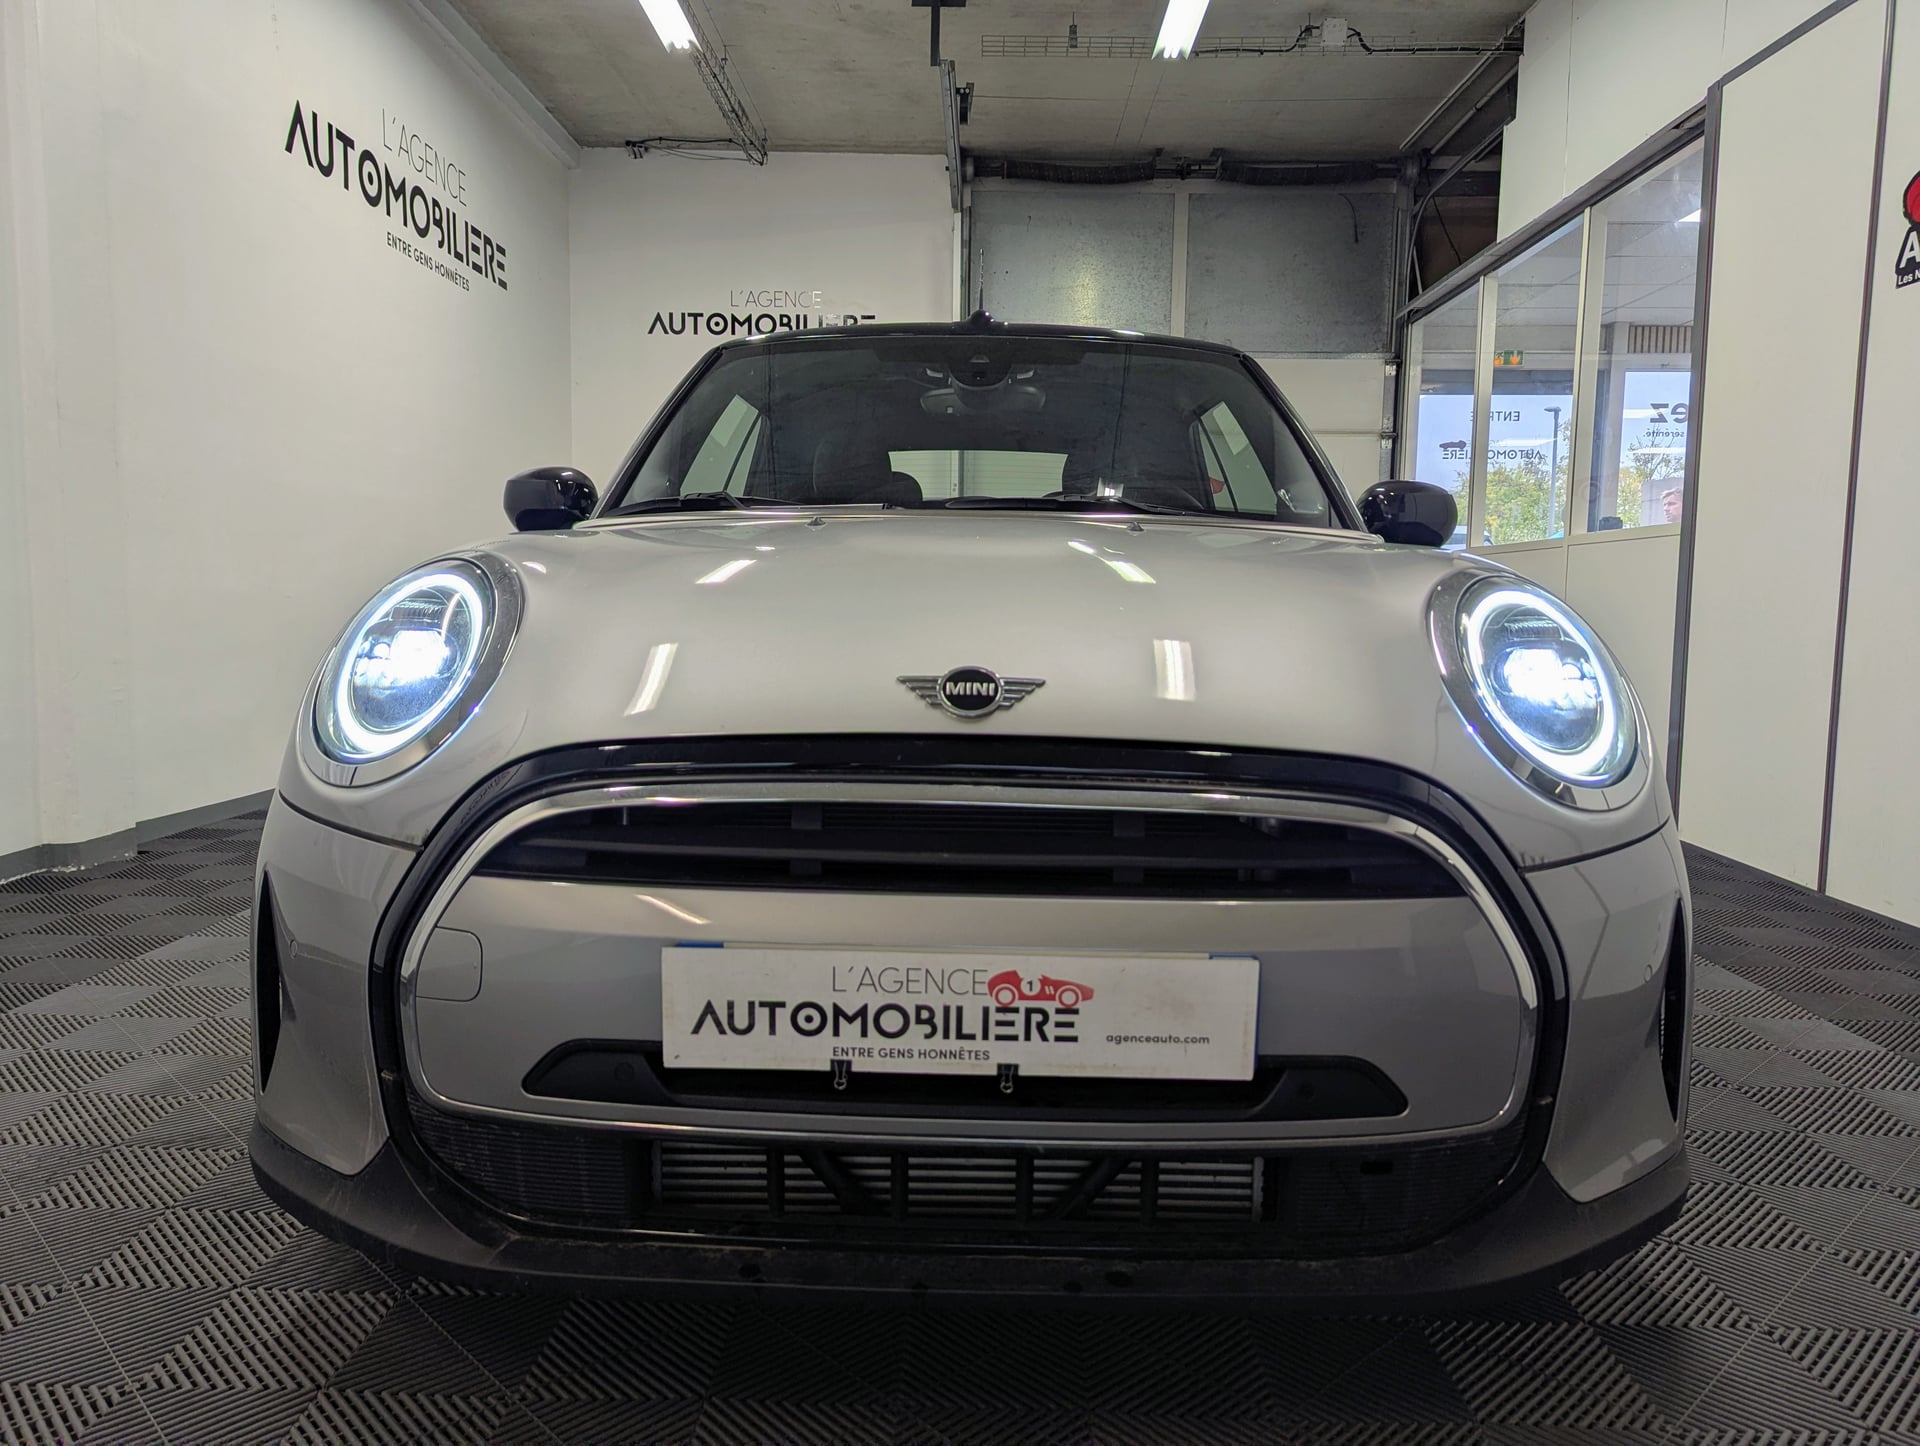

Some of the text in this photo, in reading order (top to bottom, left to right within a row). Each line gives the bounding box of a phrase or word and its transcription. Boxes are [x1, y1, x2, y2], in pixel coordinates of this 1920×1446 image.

[382, 108, 467, 207] L'AGENCE
[285, 99, 508, 291] AUTOMOBILIERE
[387, 231, 412, 258] ENTRE
[413, 247, 433, 270] GENS
[730, 289, 822, 309] L'AGENCE
[945, 681, 996, 697] MINI
[832, 965, 988, 996] L'AGENCE
[1026, 980, 1034, 992] 1
[690, 999, 1080, 1043] AUTOMOBILIERE
[1105, 1033, 1210, 1046] agenceauto.com
[832, 1046, 990, 1061] ENTRE GENS HONNÊTES
